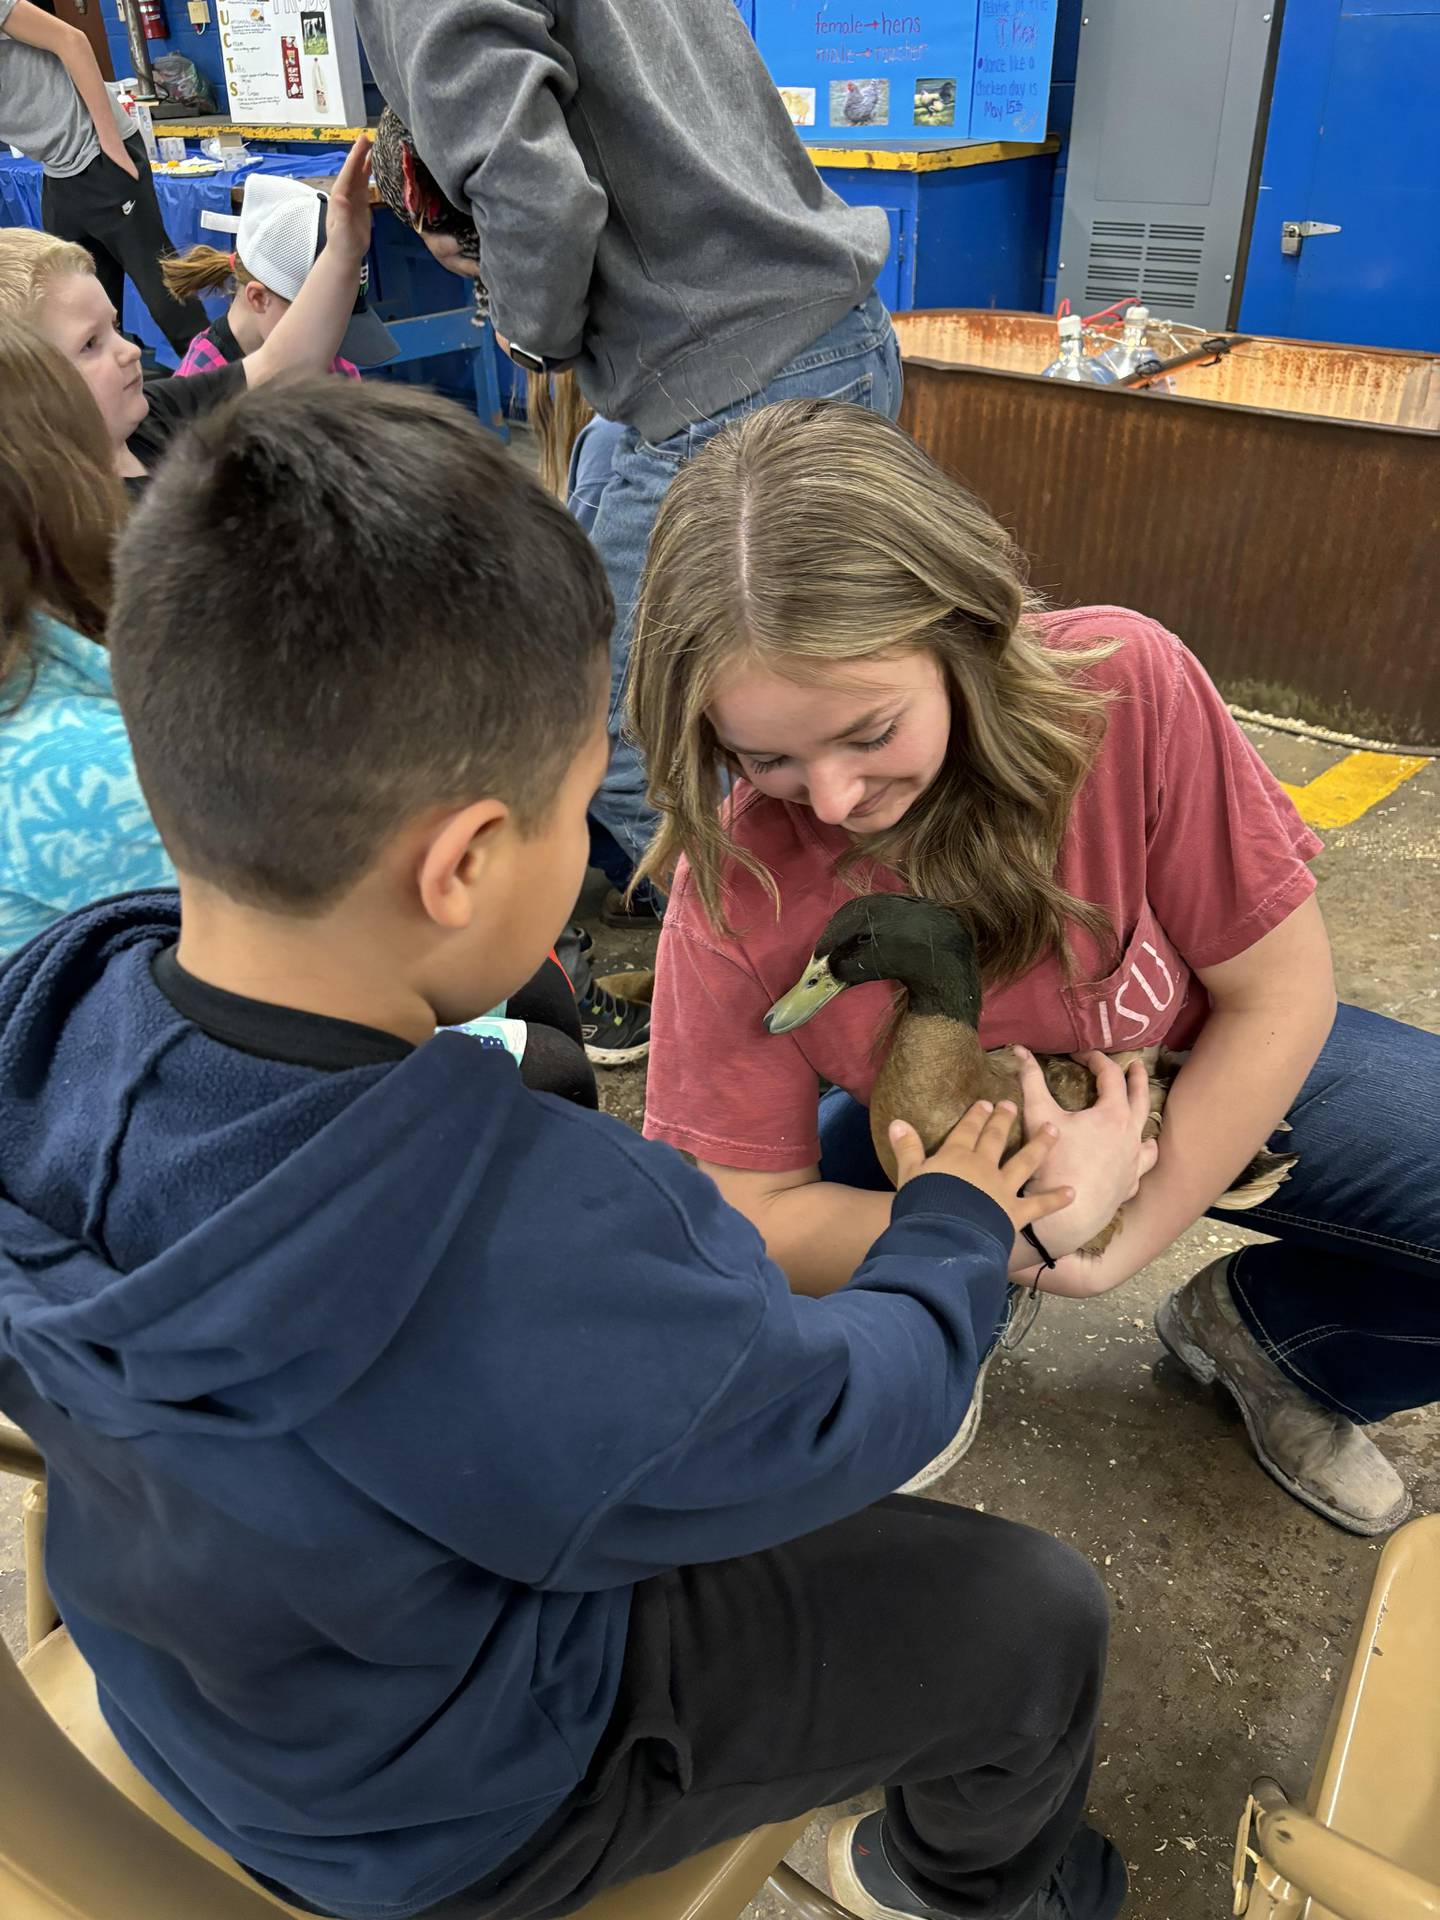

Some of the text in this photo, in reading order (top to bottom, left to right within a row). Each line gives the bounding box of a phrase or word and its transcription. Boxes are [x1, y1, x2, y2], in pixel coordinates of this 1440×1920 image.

[815, 11, 921, 36] female hens
[816, 40, 856, 64] male
[983, 56, 1008, 73] dance
[1009, 54, 1025, 72] like
[1008, 80, 1026, 97] day
[1029, 82, 1039, 96] is
[983, 101, 1003, 122] May
[1098, 940, 1175, 1049] ISU
